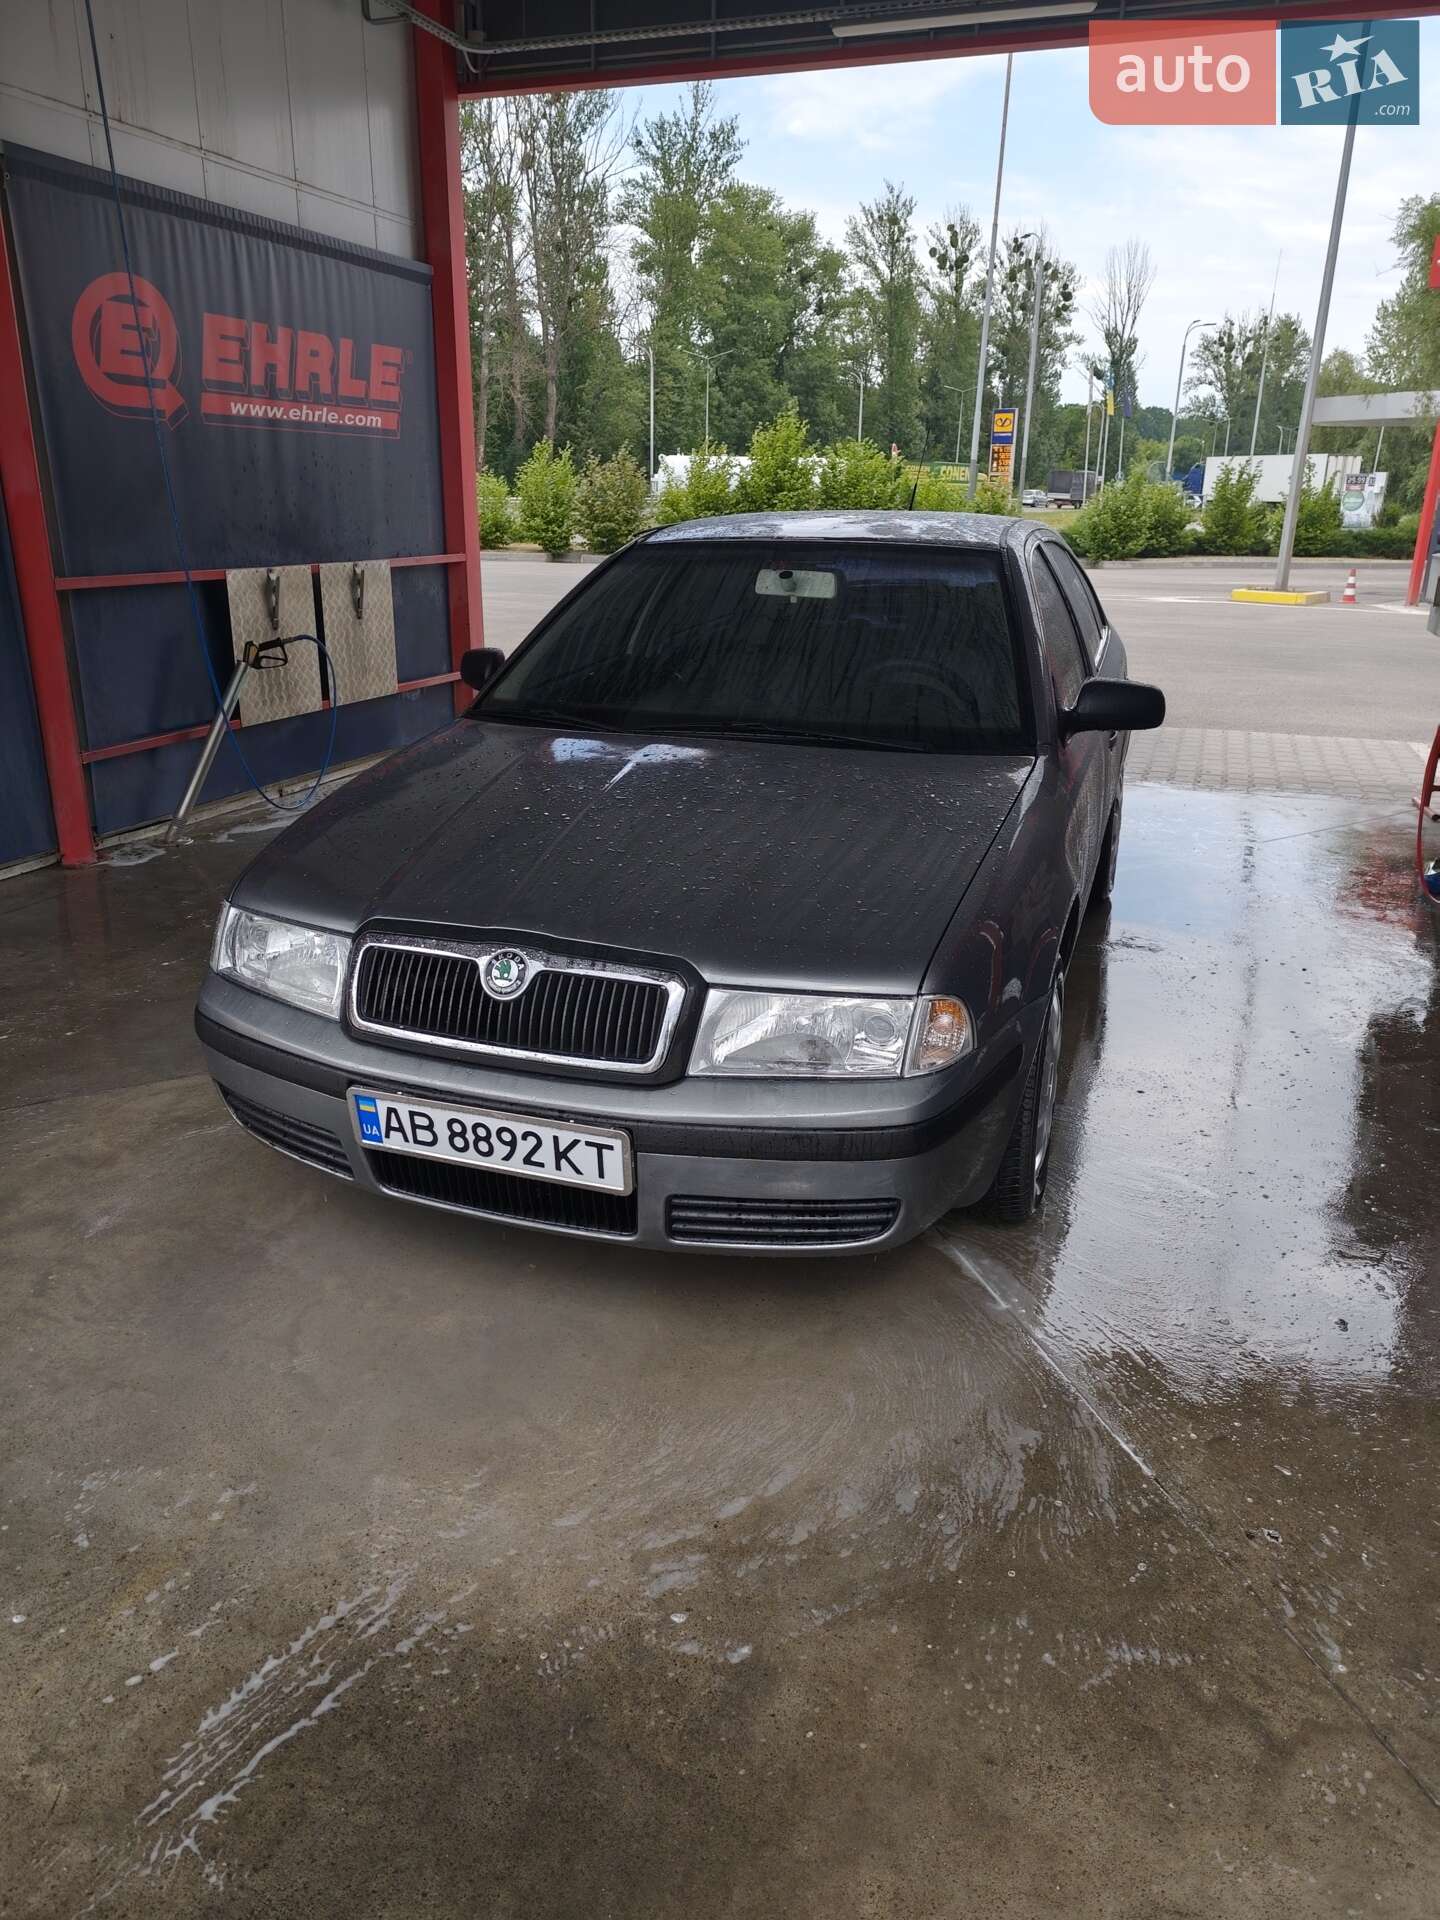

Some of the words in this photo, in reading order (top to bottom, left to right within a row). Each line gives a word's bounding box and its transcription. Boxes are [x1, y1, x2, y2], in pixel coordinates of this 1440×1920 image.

[203, 313, 404, 402] EHRLE
[230, 401, 383, 428] www.ehrle.com
[362, 1122, 380, 1138] UA
[384, 1106, 439, 1148] AB
[446, 1117, 546, 1169] 8892
[552, 1134, 615, 1180] KT
